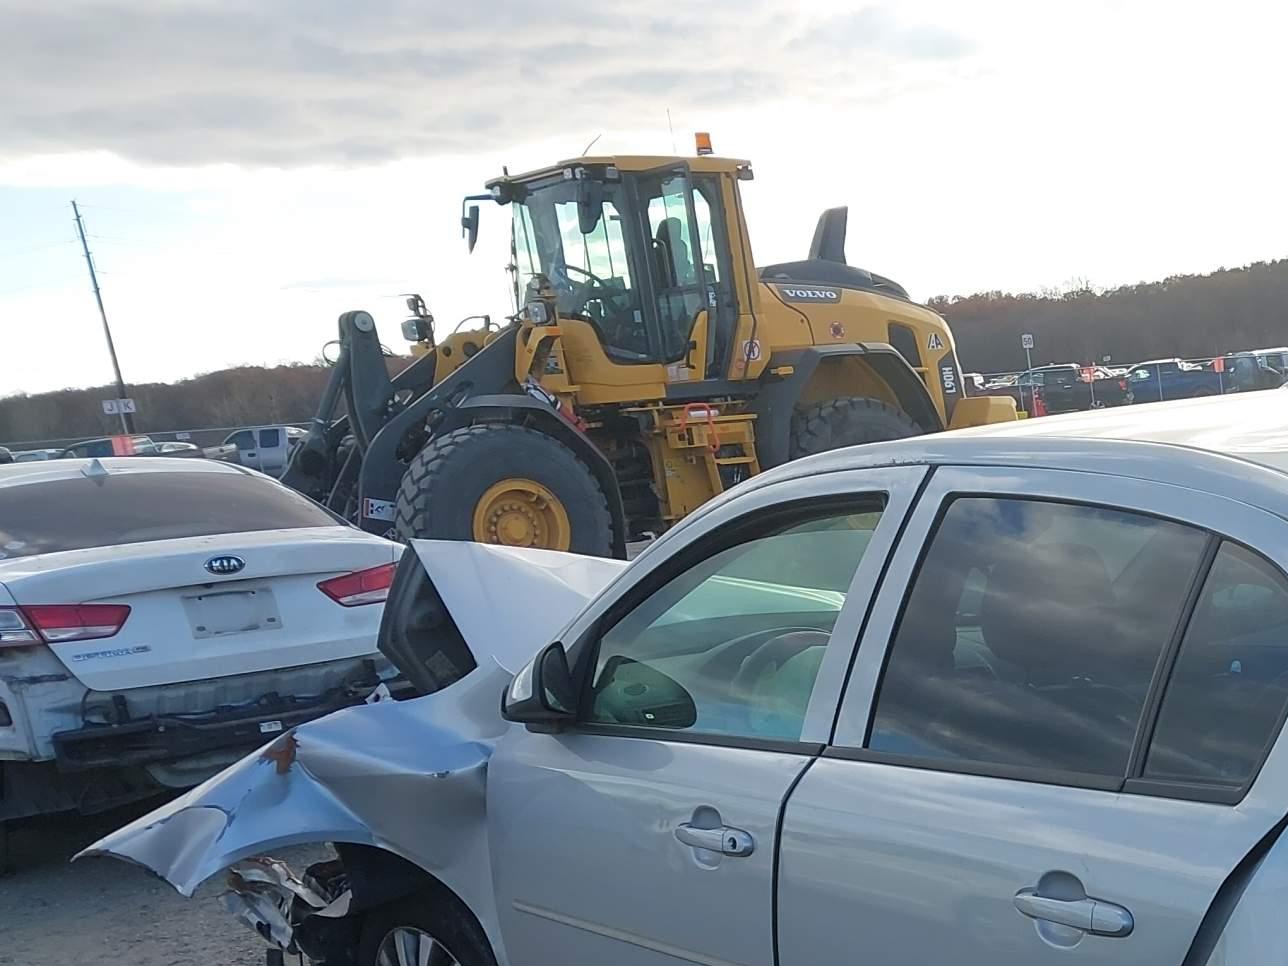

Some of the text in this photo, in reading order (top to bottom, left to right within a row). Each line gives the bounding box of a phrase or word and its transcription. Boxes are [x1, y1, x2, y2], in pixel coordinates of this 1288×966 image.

[783, 289, 837, 299] VOLVO
[941, 366, 957, 394] L90H
[211, 559, 240, 571] KIA
